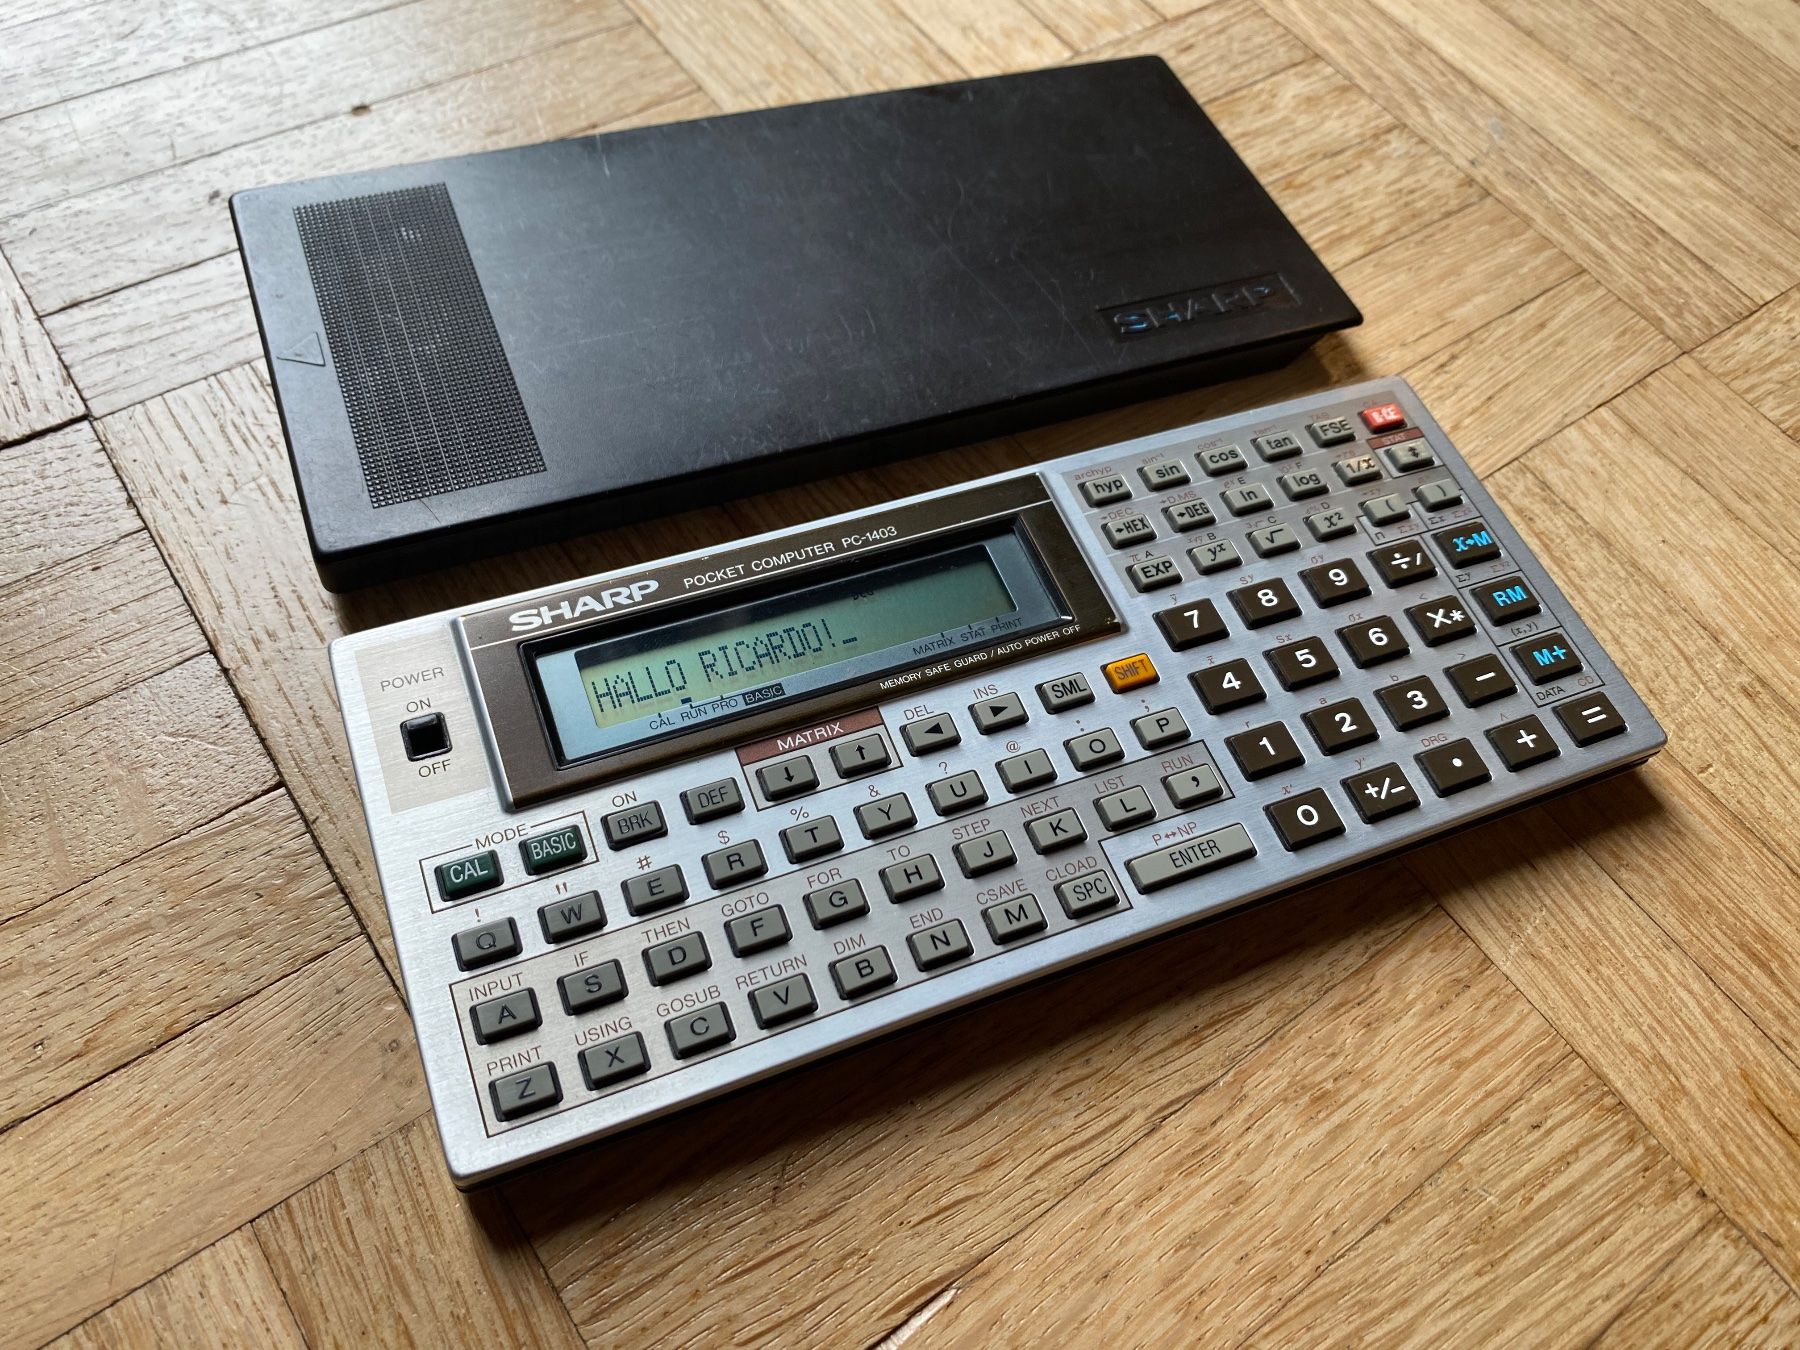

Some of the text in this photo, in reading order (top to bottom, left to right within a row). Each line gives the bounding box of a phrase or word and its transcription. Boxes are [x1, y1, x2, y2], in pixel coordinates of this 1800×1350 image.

[1319, 420, 1352, 437] FSE
[1266, 436, 1294, 450] tan
[1209, 449, 1239, 464] cos
[1074, 465, 1112, 481] archyp
[1155, 464, 1181, 480] sin
[1292, 472, 1321, 487] log
[1092, 477, 1124, 494] hyp
[683, 525, 898, 589] POCKET COMPUTER PC-1403
[1140, 560, 1173, 579] EXP
[1328, 568, 1348, 586] 9
[508, 579, 660, 632] SHARP
[1257, 588, 1278, 607] 8
[1493, 584, 1529, 607] RM
[991, 617, 1024, 634] PRINT
[1183, 609, 1199, 629] 7
[960, 628, 987, 642] STAT
[1368, 627, 1388, 646] 6
[913, 635, 956, 656] MATRIX
[1532, 645, 1567, 666] M+
[591, 618, 836, 713] HALLO RICARDO!
[880, 671, 922, 690] MEMORY
[925, 662, 952, 677] SAFE
[954, 652, 988, 669] GUARD
[997, 641, 1023, 656] AUTO
[1025, 630, 1060, 648] POWER
[1063, 624, 1081, 637] OFF
[1294, 648, 1317, 668] 5
[379, 666, 446, 692] POWER
[1114, 659, 1149, 681] SHIFT
[1051, 678, 1087, 699] SML
[1222, 671, 1241, 690] 4
[744, 684, 785, 705] BASIC
[973, 684, 999, 700] INS
[1406, 690, 1428, 710] 3
[1536, 685, 1566, 701] DATA
[406, 697, 432, 714] ON
[680, 706, 708, 722] RUN
[712, 697, 739, 713] PRO
[903, 704, 934, 721] DEL
[649, 715, 676, 730] CAL
[1156, 717, 1170, 733] P
[1334, 712, 1358, 733] 2
[776, 722, 845, 751] MATRIX
[1006, 740, 1020, 752] @
[1088, 738, 1106, 754] O
[1259, 736, 1276, 756] 1
[1420, 732, 1449, 748] DRG
[418, 759, 452, 778] OFF
[938, 761, 949, 775] ?
[1161, 754, 1194, 774] RUN
[868, 784, 881, 798] &
[949, 780, 967, 799] U
[1095, 774, 1127, 795] LIST
[1364, 777, 1406, 800] +/-
[612, 791, 637, 808] ON
[697, 786, 729, 808] DEF
[1020, 795, 1061, 819] NEXT
[1120, 798, 1137, 813] L
[790, 806, 809, 821] %
[876, 803, 893, 821] Y
[1296, 804, 1319, 826] 0
[617, 812, 654, 835] BRK
[951, 818, 991, 841] STEP
[1049, 818, 1069, 837] K
[475, 823, 530, 850] MODE
[717, 829, 731, 845] $
[803, 826, 820, 844] T
[531, 832, 577, 860] BASIC
[886, 844, 911, 861] TO
[983, 840, 994, 858] J
[1169, 839, 1221, 869] ENTER
[450, 858, 488, 883] CAL
[636, 855, 652, 871] #
[726, 852, 745, 871] R
[1045, 855, 1098, 882] CLOAD
[806, 867, 842, 889] FOR
[903, 865, 921, 884] H
[647, 877, 665, 897] E
[976, 879, 1028, 905] CSAVE
[1073, 878, 1108, 902] SPC
[721, 891, 770, 917] GOTO
[829, 890, 849, 908] G
[561, 903, 583, 925] W
[909, 907, 944, 929] END
[1004, 903, 1029, 925] M
[641, 919, 691, 943] THEN
[750, 917, 764, 937] F
[476, 932, 497, 950] Q
[833, 933, 867, 955] DIM
[930, 930, 950, 950] N
[574, 951, 590, 967] IF
[668, 946, 687, 966] D
[735, 953, 808, 990] RETURN
[855, 959, 875, 978] B
[469, 972, 523, 1002] INPUT
[584, 974, 603, 994] S
[656, 985, 721, 1018] GOSUB
[773, 987, 790, 1005] V
[497, 1005, 517, 1024] A
[574, 1016, 633, 1047] USING
[690, 1016, 710, 1036] C
[486, 1045, 542, 1077] PRINT
[604, 1046, 625, 1067] X
[515, 1077, 536, 1099] Z
